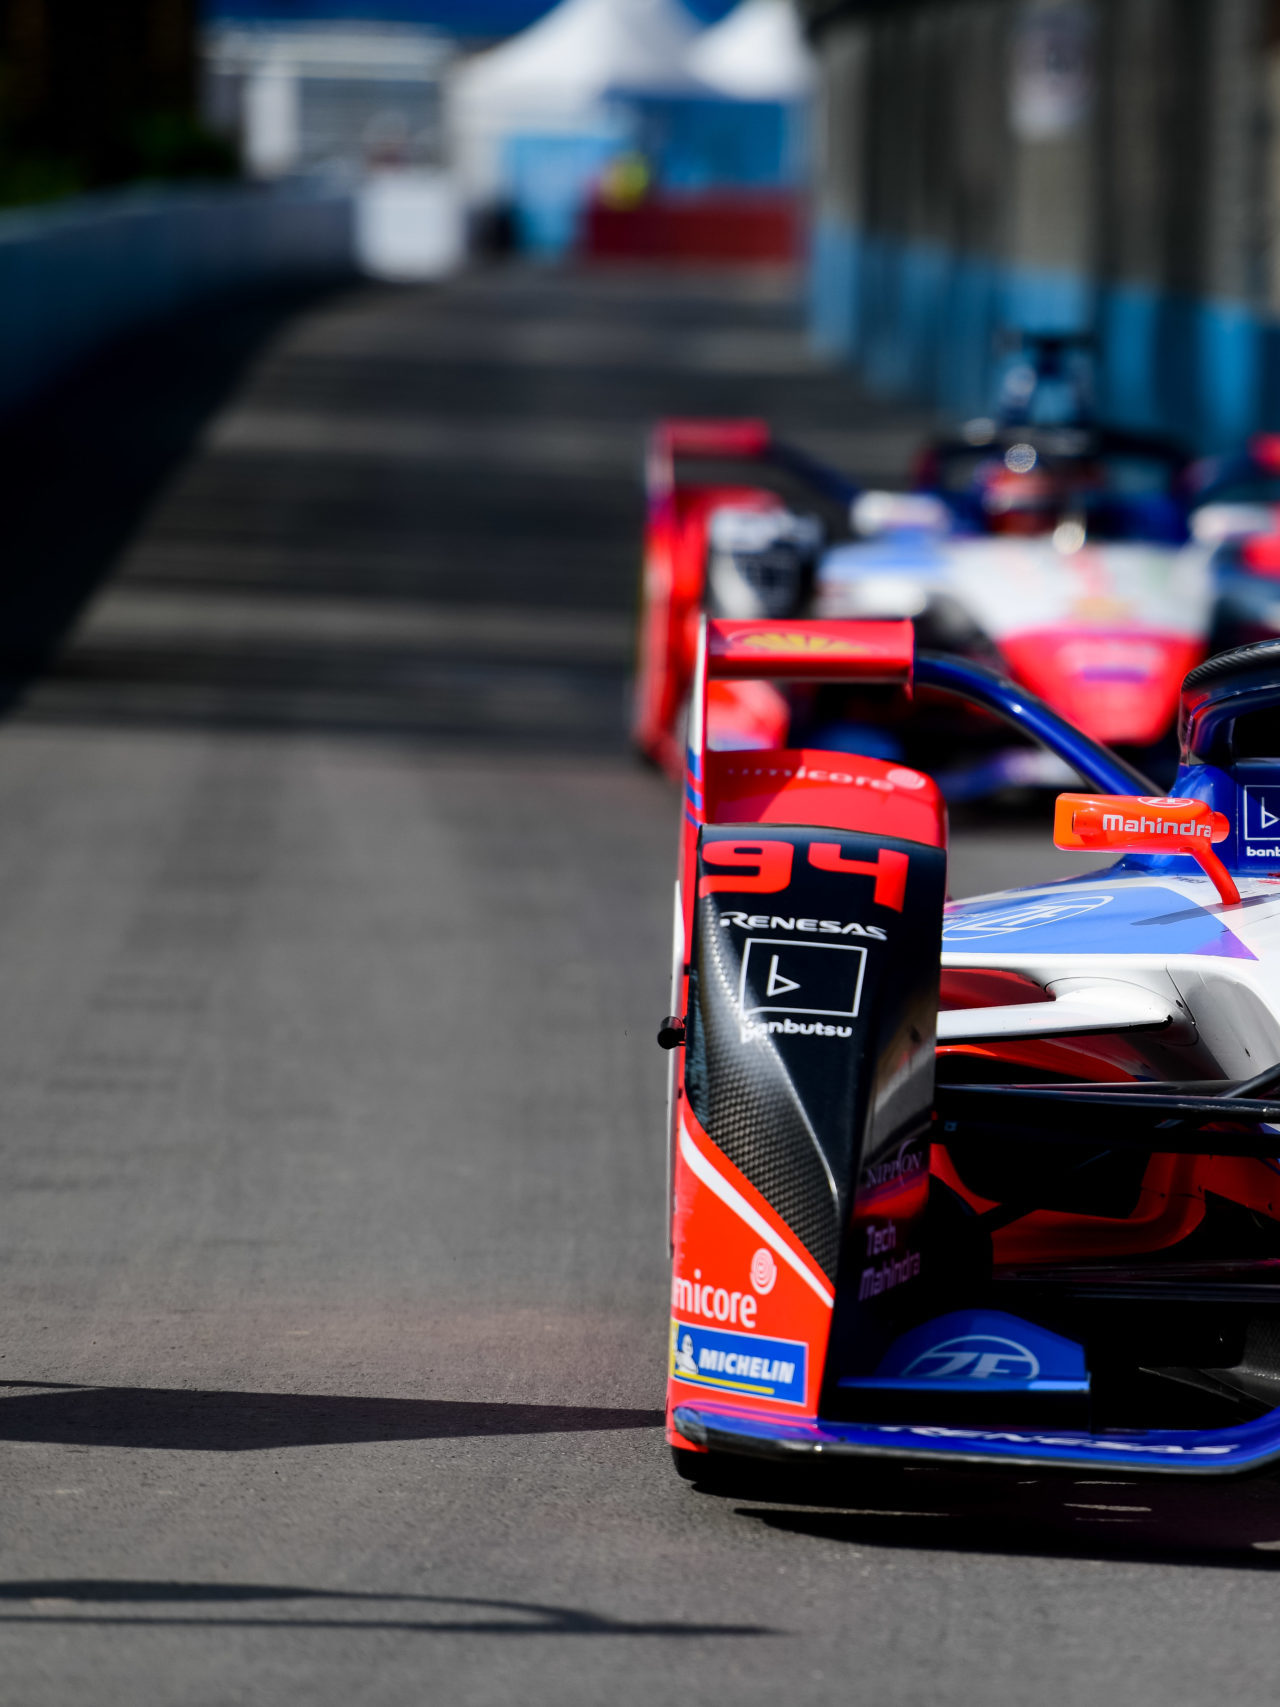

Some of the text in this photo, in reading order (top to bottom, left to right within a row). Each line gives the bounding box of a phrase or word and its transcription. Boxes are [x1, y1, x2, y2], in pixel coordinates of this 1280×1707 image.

[1102, 814, 1212, 838] Mahindra
[698, 840, 909, 913] 94
[719, 911, 888, 941] RENESAS
[866, 1219, 897, 1257] Tech
[672, 1268, 758, 1328] micore
[699, 1348, 796, 1384] MICHELIN
